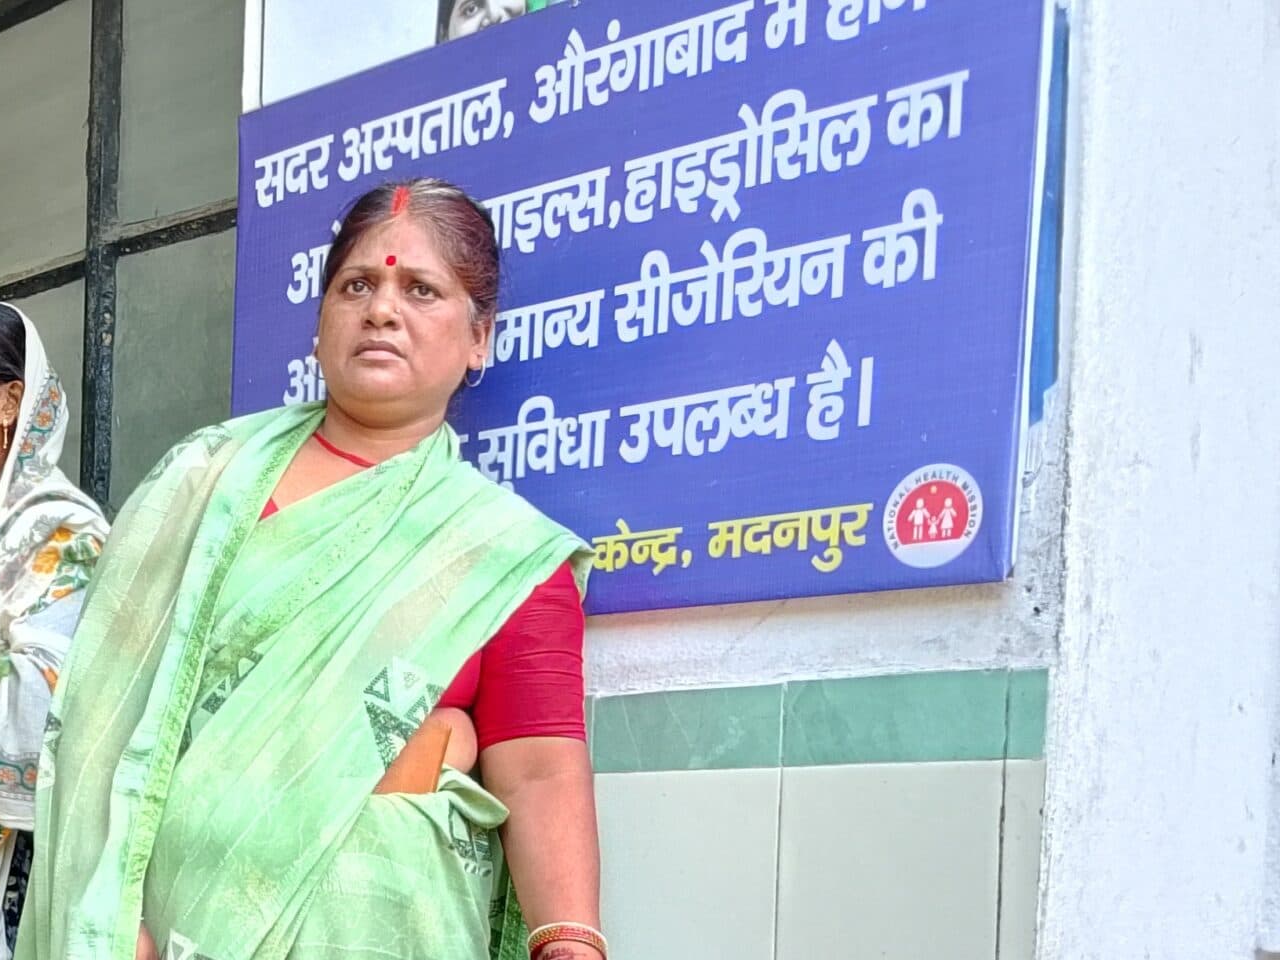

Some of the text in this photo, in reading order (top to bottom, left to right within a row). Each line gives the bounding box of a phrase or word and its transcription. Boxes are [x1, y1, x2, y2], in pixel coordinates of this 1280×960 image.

[255, 134, 334, 208] सदर
[338, 78, 515, 182] अस्पताल,
[528, 0, 754, 125] औरंगाबाद
[887, 69, 969, 150] का
[614, 227, 850, 342] सीजेरियन
[862, 189, 943, 289] की
[619, 375, 796, 464] उपलब्ध
[805, 338, 874, 441] है।
[592, 503, 874, 576] केन्द्र, मदनपुर
[887, 470, 978, 550] NATIONAL HEALTH MISSION
